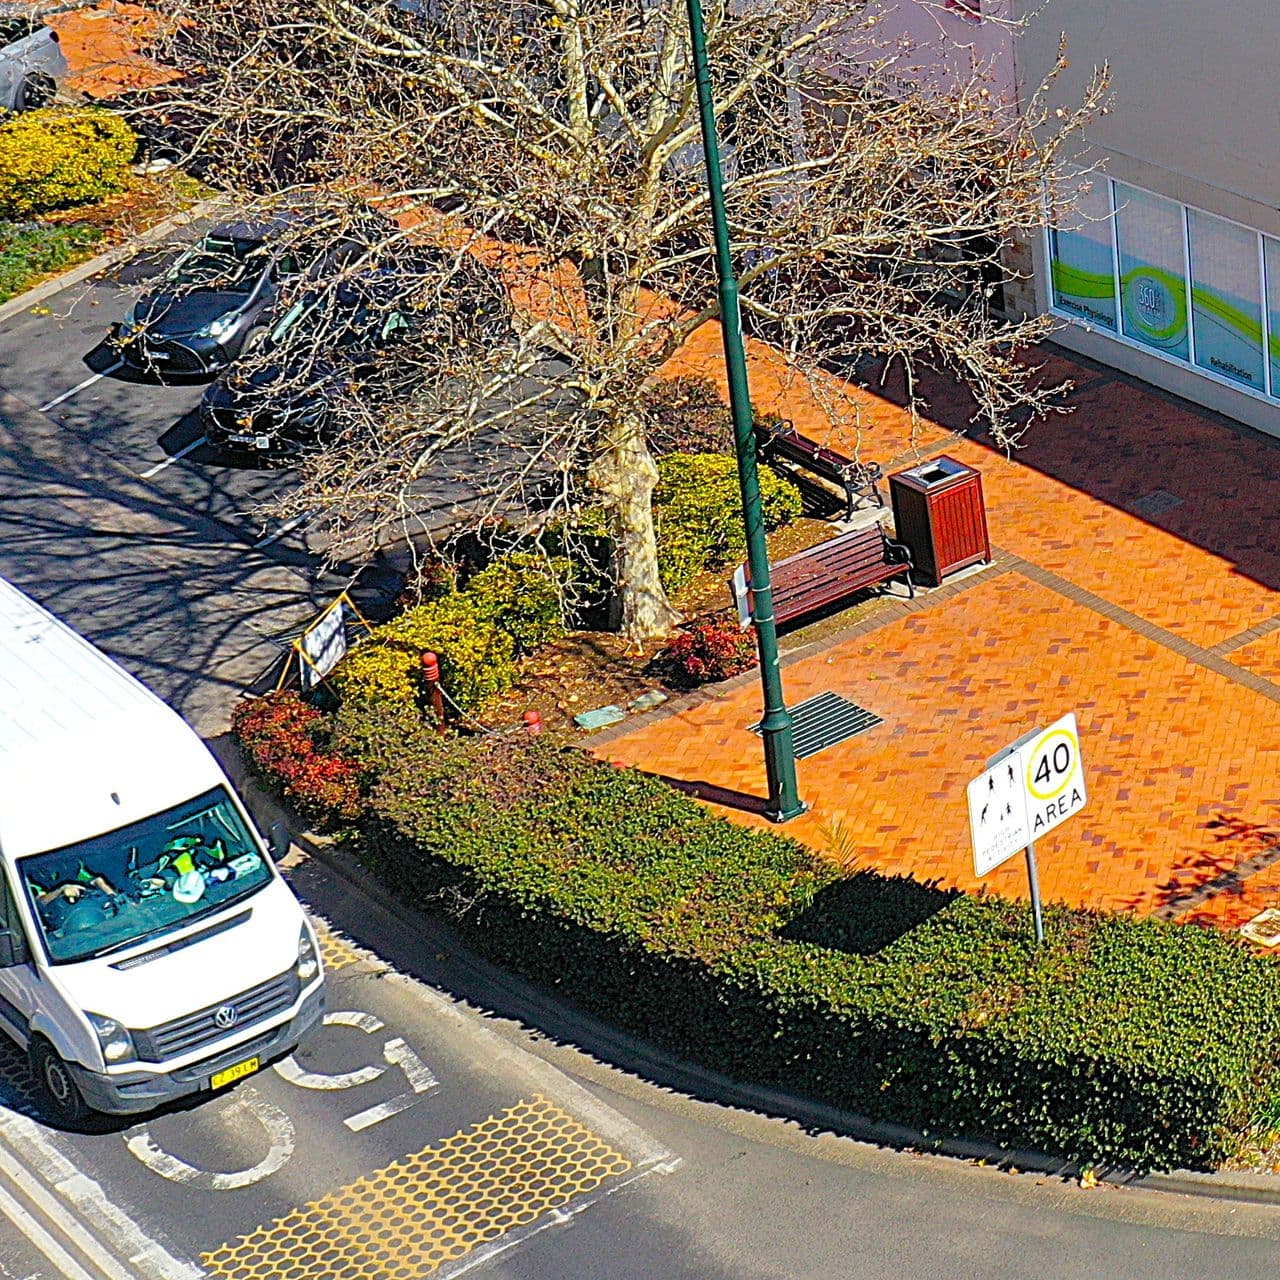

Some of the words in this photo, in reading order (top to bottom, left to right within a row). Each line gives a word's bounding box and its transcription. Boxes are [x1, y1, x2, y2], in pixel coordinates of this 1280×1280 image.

[1139, 284, 1155, 309] 360
[1210, 356, 1252, 381] Rehabilitation
[1034, 742, 1070, 784] 40
[1033, 788, 1082, 833] AREA
